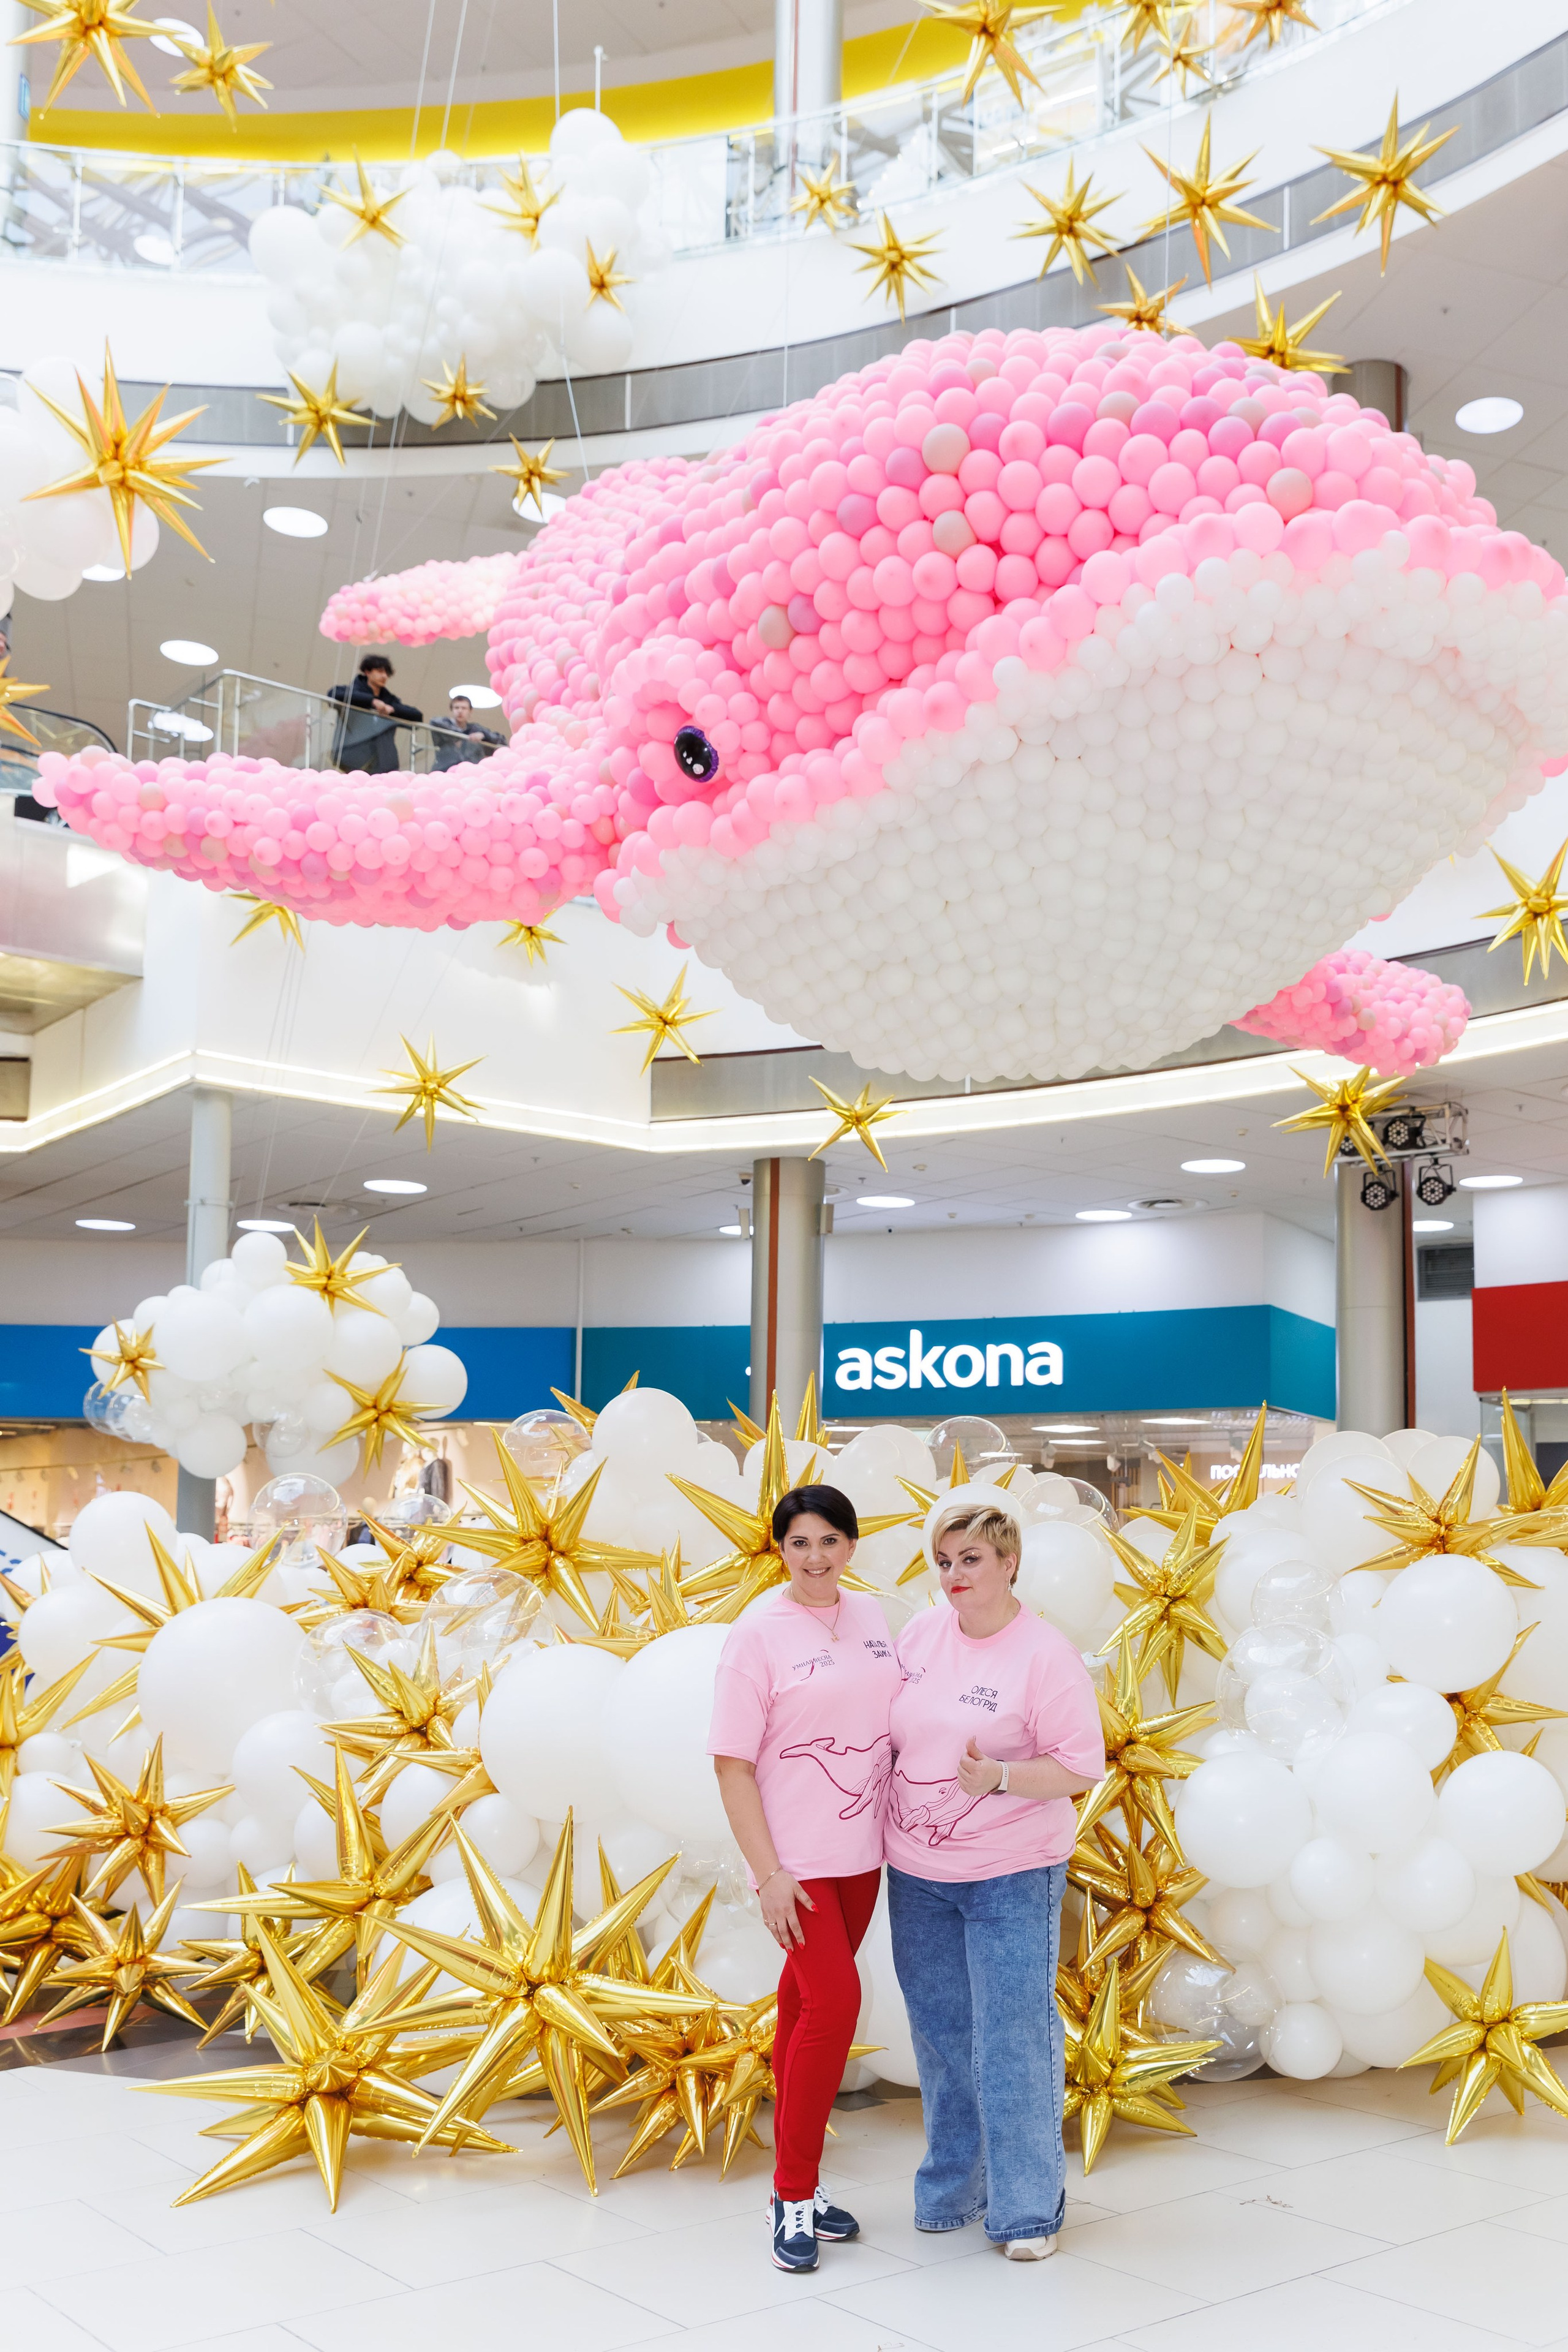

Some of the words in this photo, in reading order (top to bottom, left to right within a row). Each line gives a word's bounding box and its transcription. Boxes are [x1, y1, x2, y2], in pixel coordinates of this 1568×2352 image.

[835, 1329, 1063, 1390] askona
[792, 1659, 813, 1671] УМНАЯ
[819, 1659, 835, 1667] 2025
[971, 1685, 998, 1699] ОЛЕСЯ
[959, 1694, 998, 1713] БЕЛОГРУД
